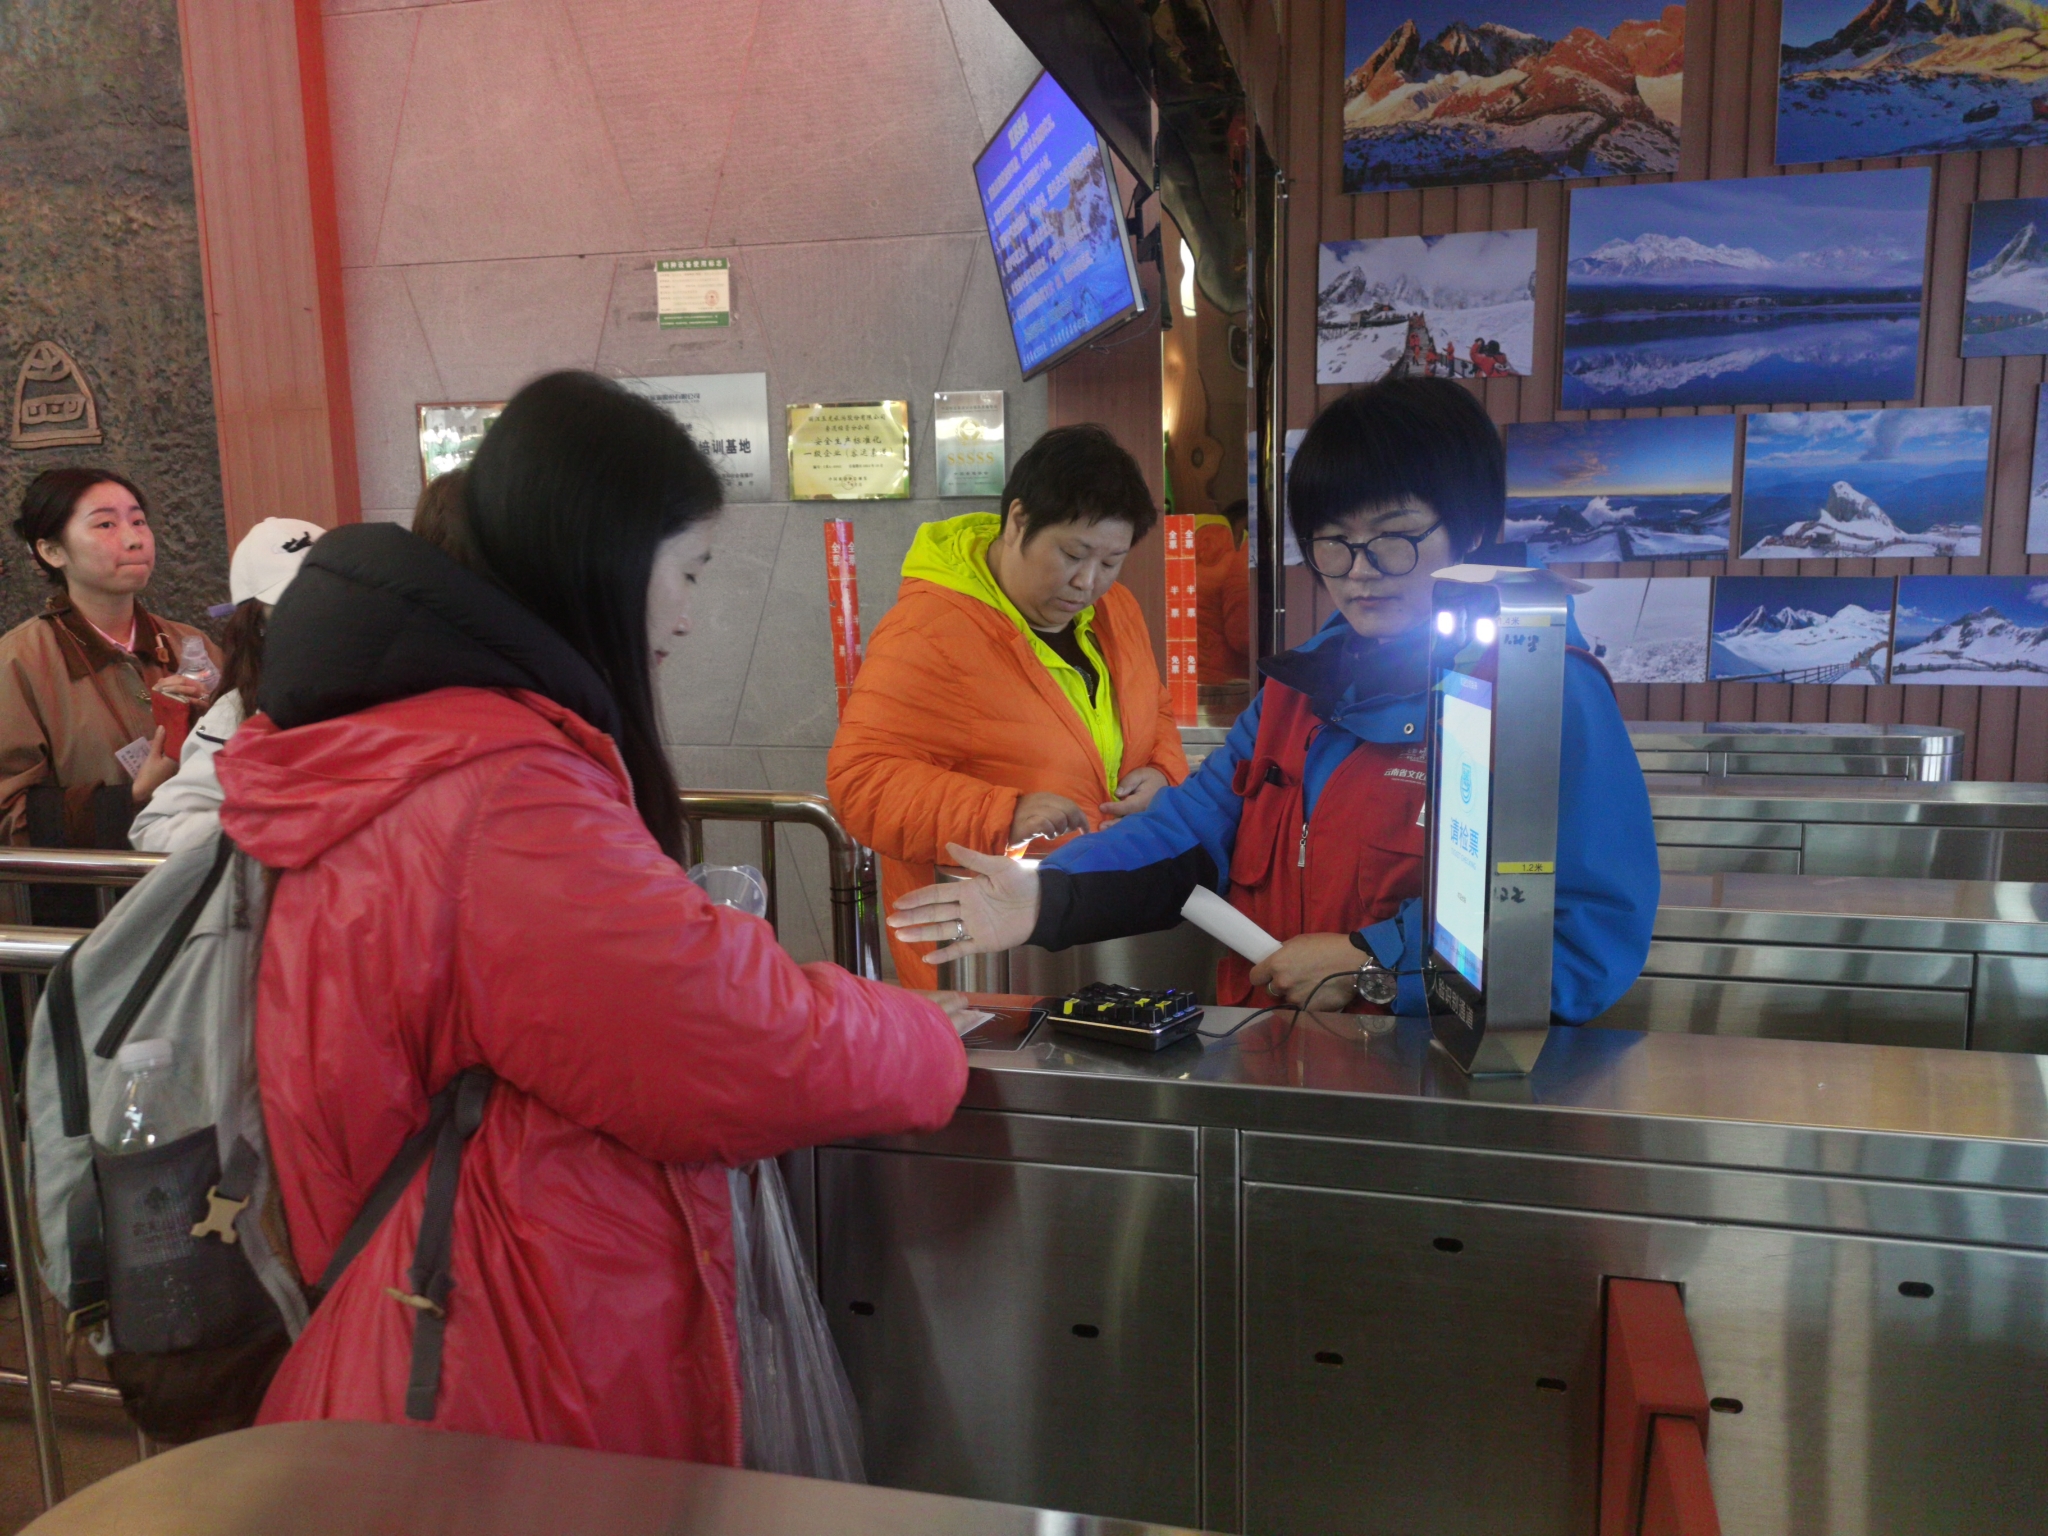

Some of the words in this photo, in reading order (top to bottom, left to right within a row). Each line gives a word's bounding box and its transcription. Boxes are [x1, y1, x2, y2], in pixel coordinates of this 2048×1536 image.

[814, 436, 882, 446] 安全生产标准化
[1169, 530, 1178, 549] 全票
[1185, 530, 1194, 549] 全票
[831, 542, 841, 566] 全票
[1171, 655, 1180, 675] 免票
[1187, 655, 1196, 675] 免票
[1383, 767, 1427, 781] 云南省文化
[1450, 817, 1479, 858] 请检票
[1522, 863, 1543, 872] 1.2米
